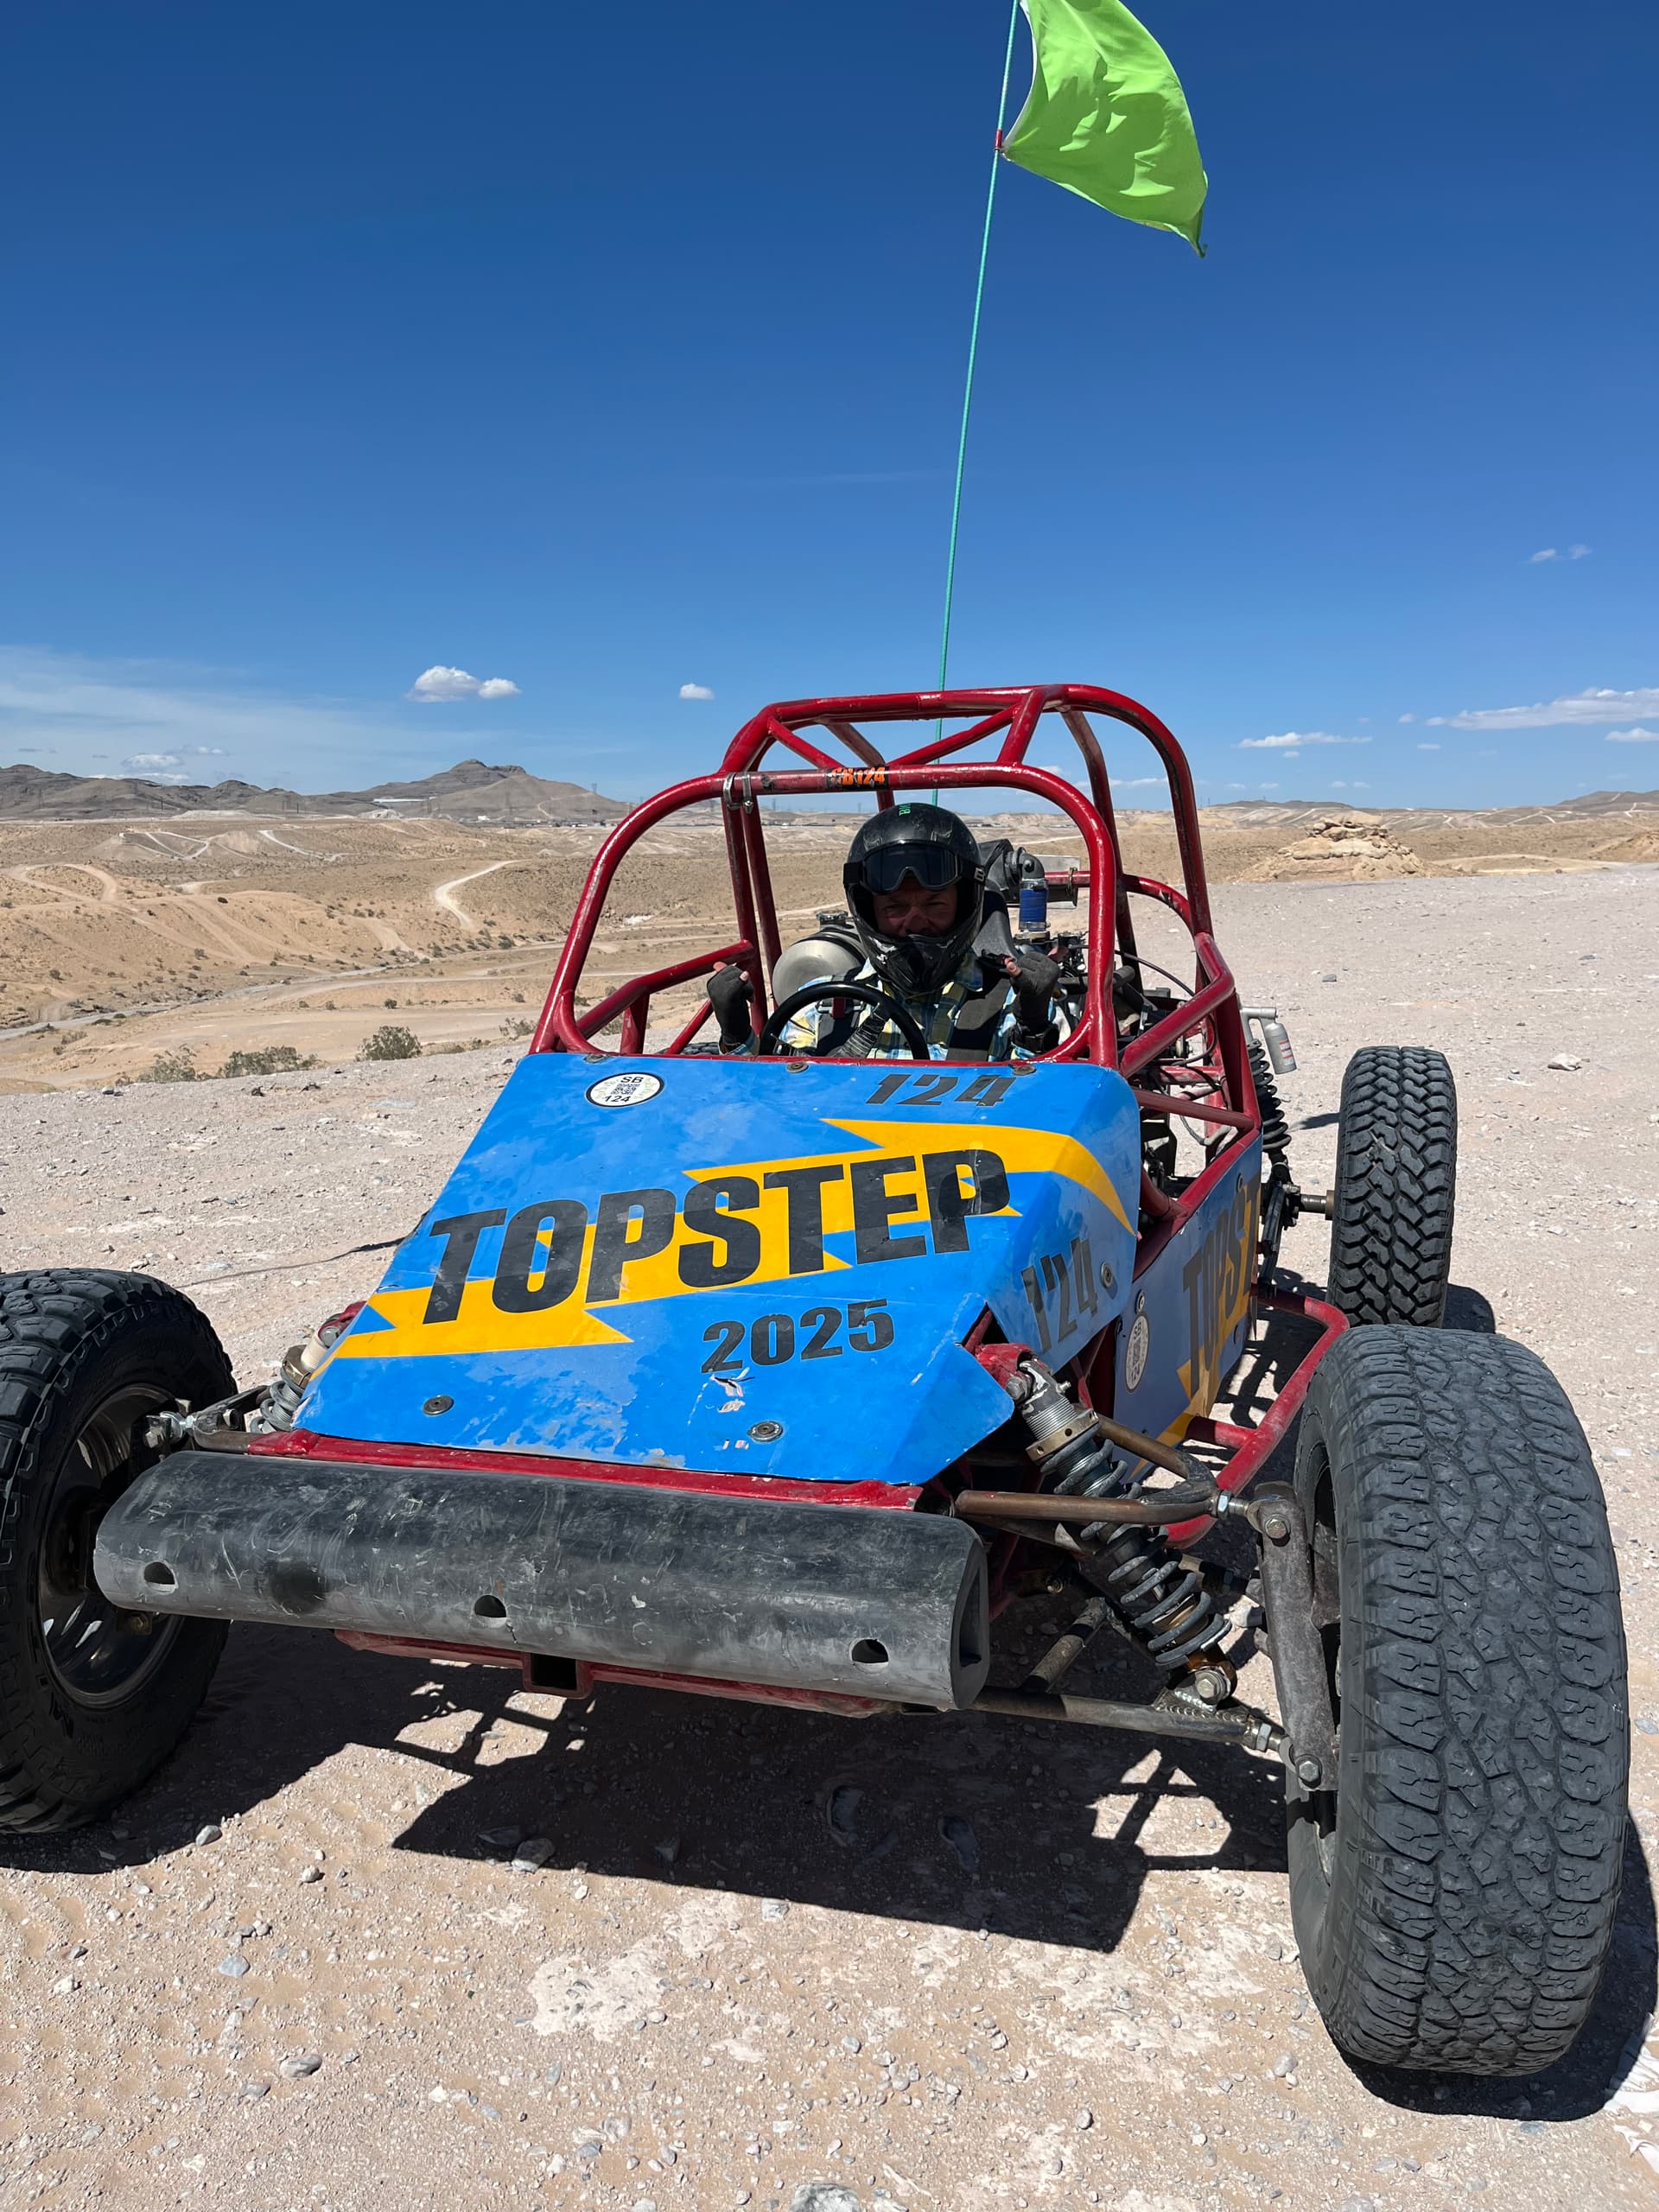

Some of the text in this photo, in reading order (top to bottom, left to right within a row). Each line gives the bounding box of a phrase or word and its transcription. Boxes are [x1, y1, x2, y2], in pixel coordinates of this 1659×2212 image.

[865, 1074, 1016, 1106] 124
[423, 1149, 1010, 1325] TOPSTEP
[702, 1299, 894, 1373] 2025
[1020, 1236, 1098, 1354] 124
